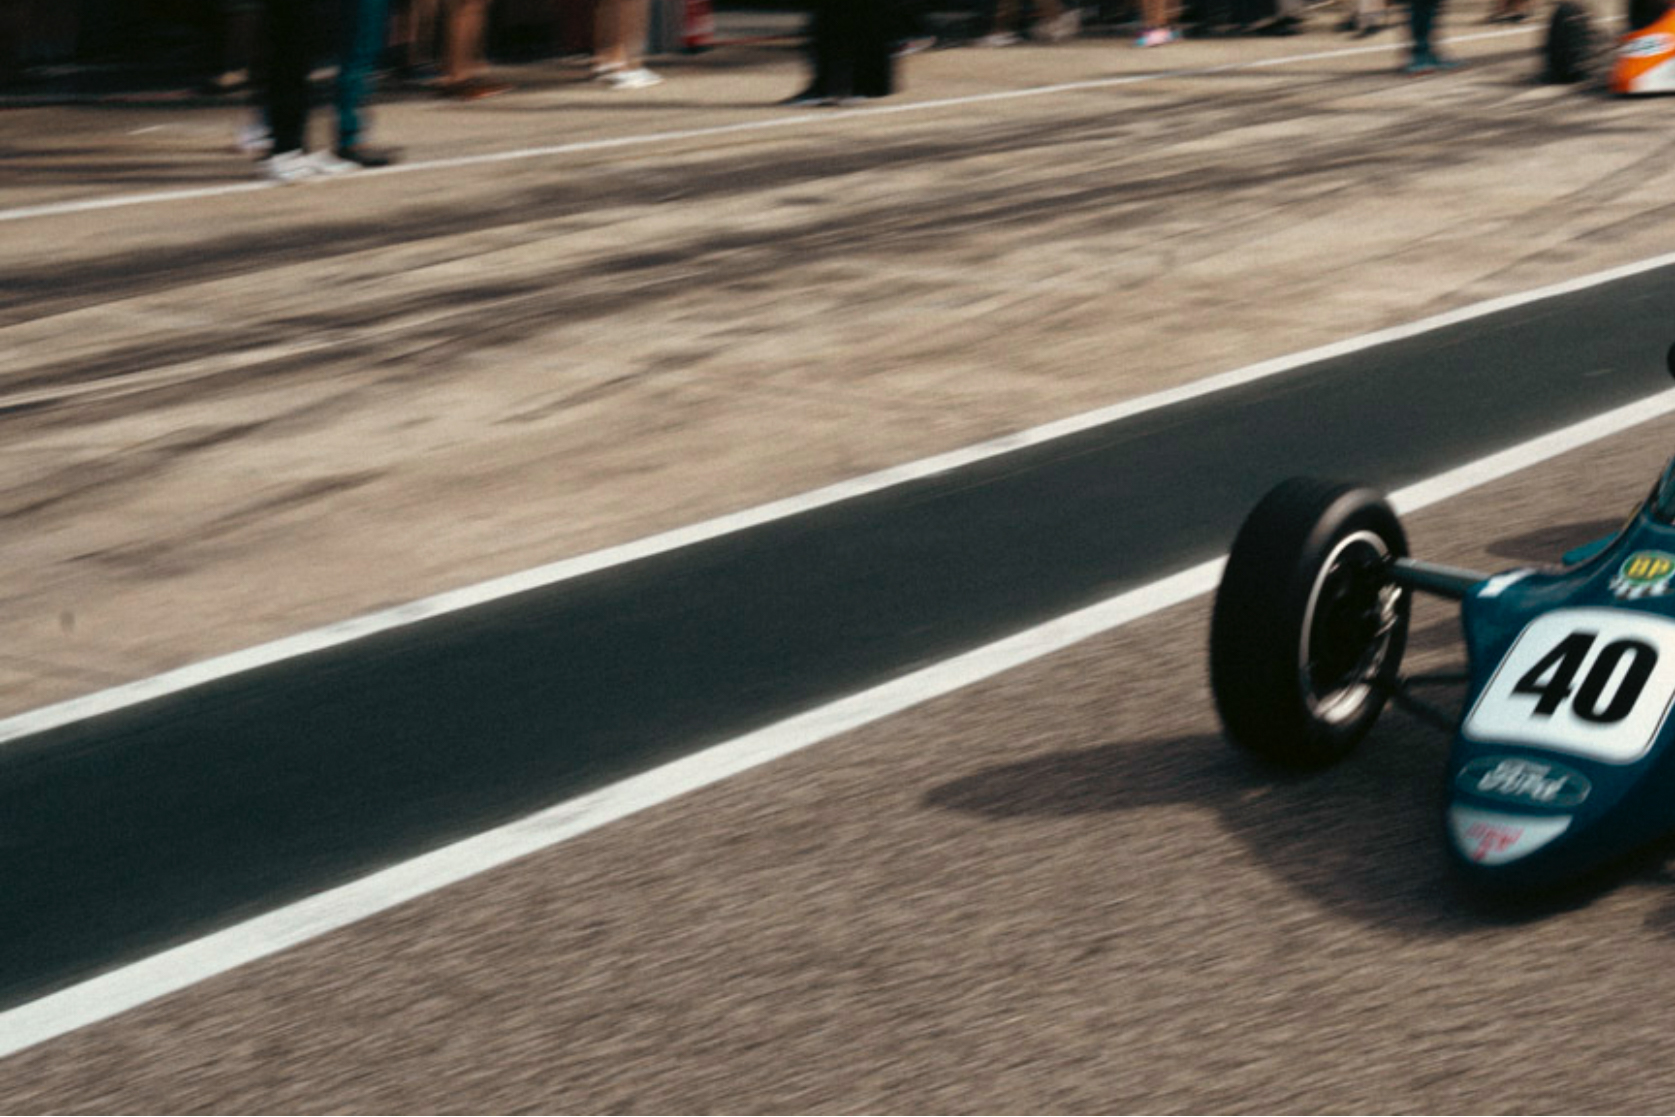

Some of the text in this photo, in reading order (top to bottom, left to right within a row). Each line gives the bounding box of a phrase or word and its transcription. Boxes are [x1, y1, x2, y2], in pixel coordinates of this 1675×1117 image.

[1627, 555, 1672, 578] BP
[1509, 630, 1658, 725] 40
[1476, 758, 1569, 803] Ford
